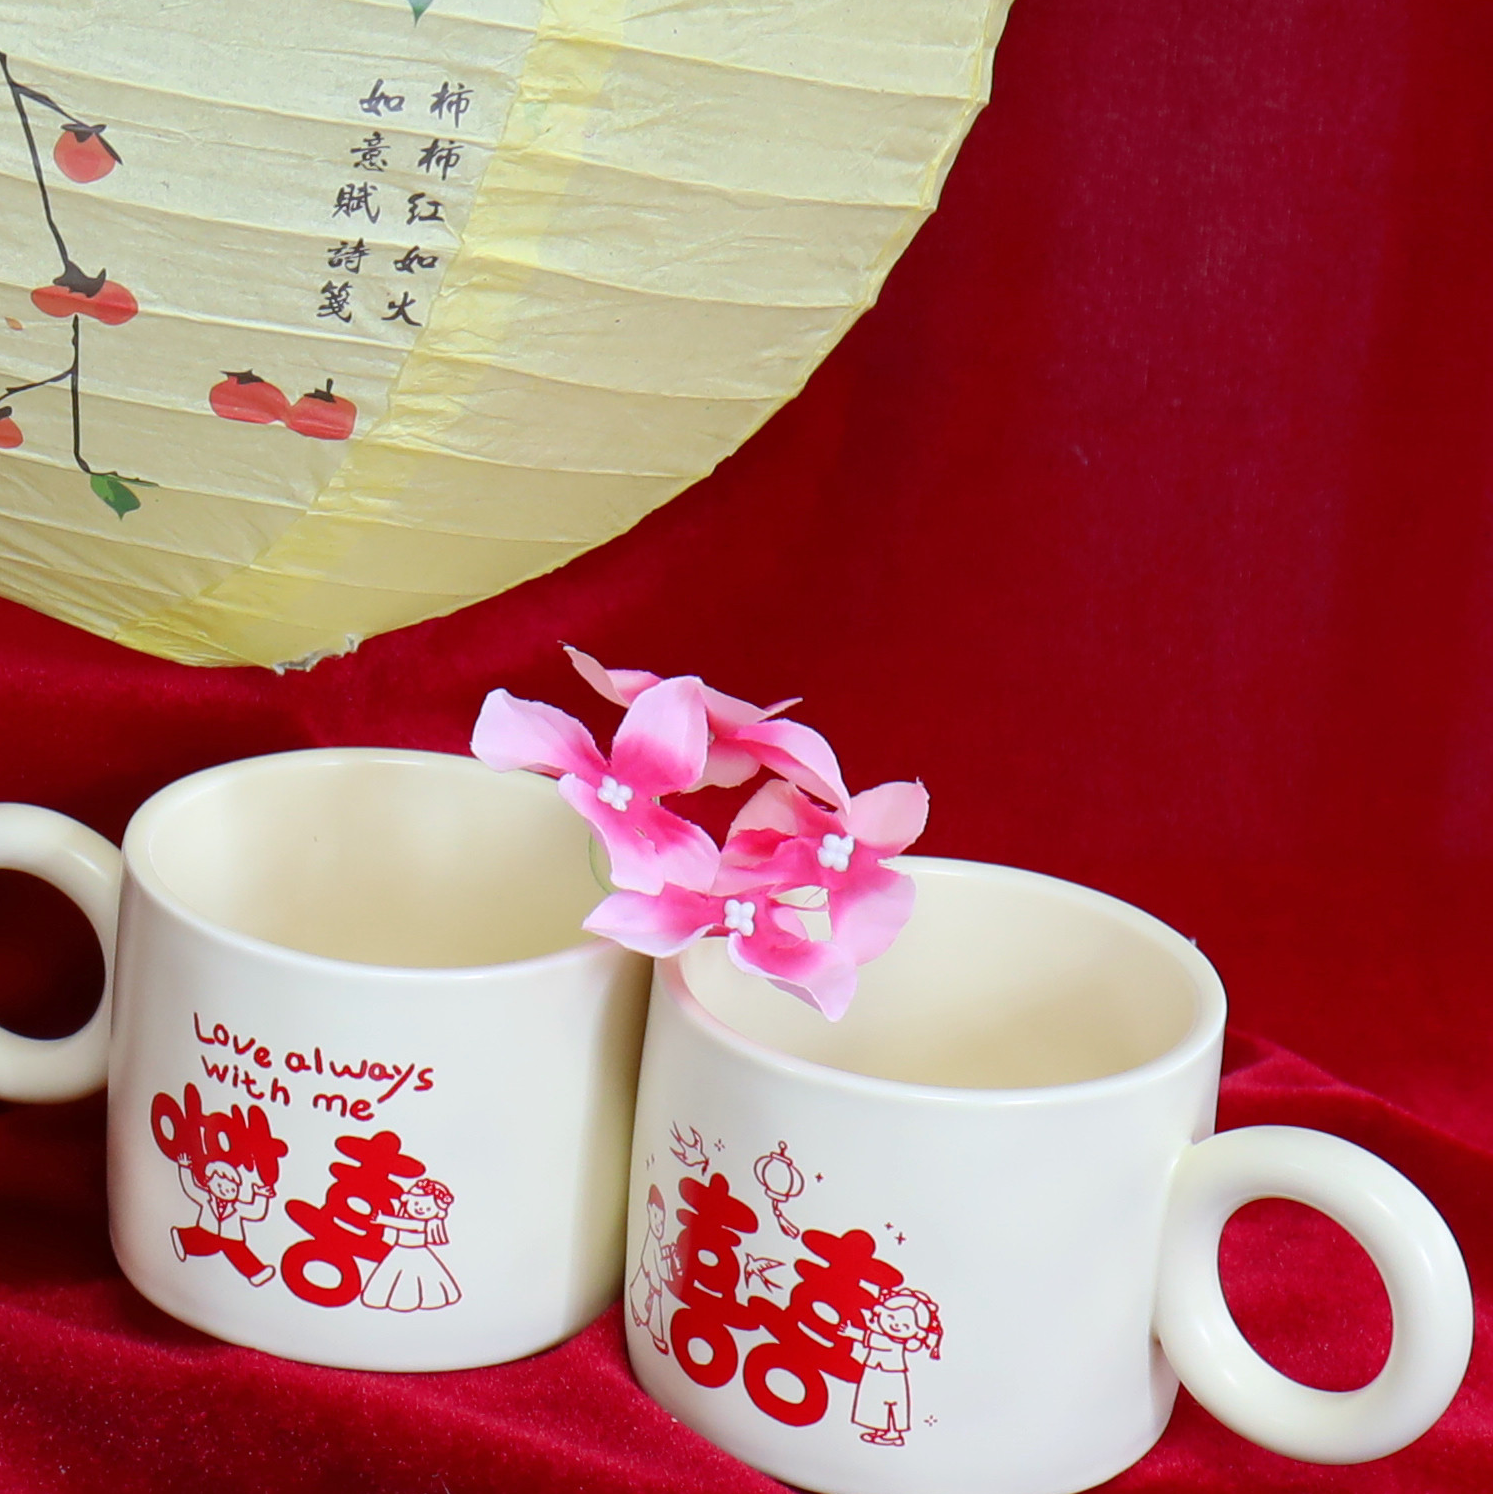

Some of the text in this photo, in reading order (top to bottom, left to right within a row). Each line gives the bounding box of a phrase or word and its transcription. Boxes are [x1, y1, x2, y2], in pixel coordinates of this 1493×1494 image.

[193, 1011, 435, 1105] Love always
[200, 1055, 376, 1122] with me
